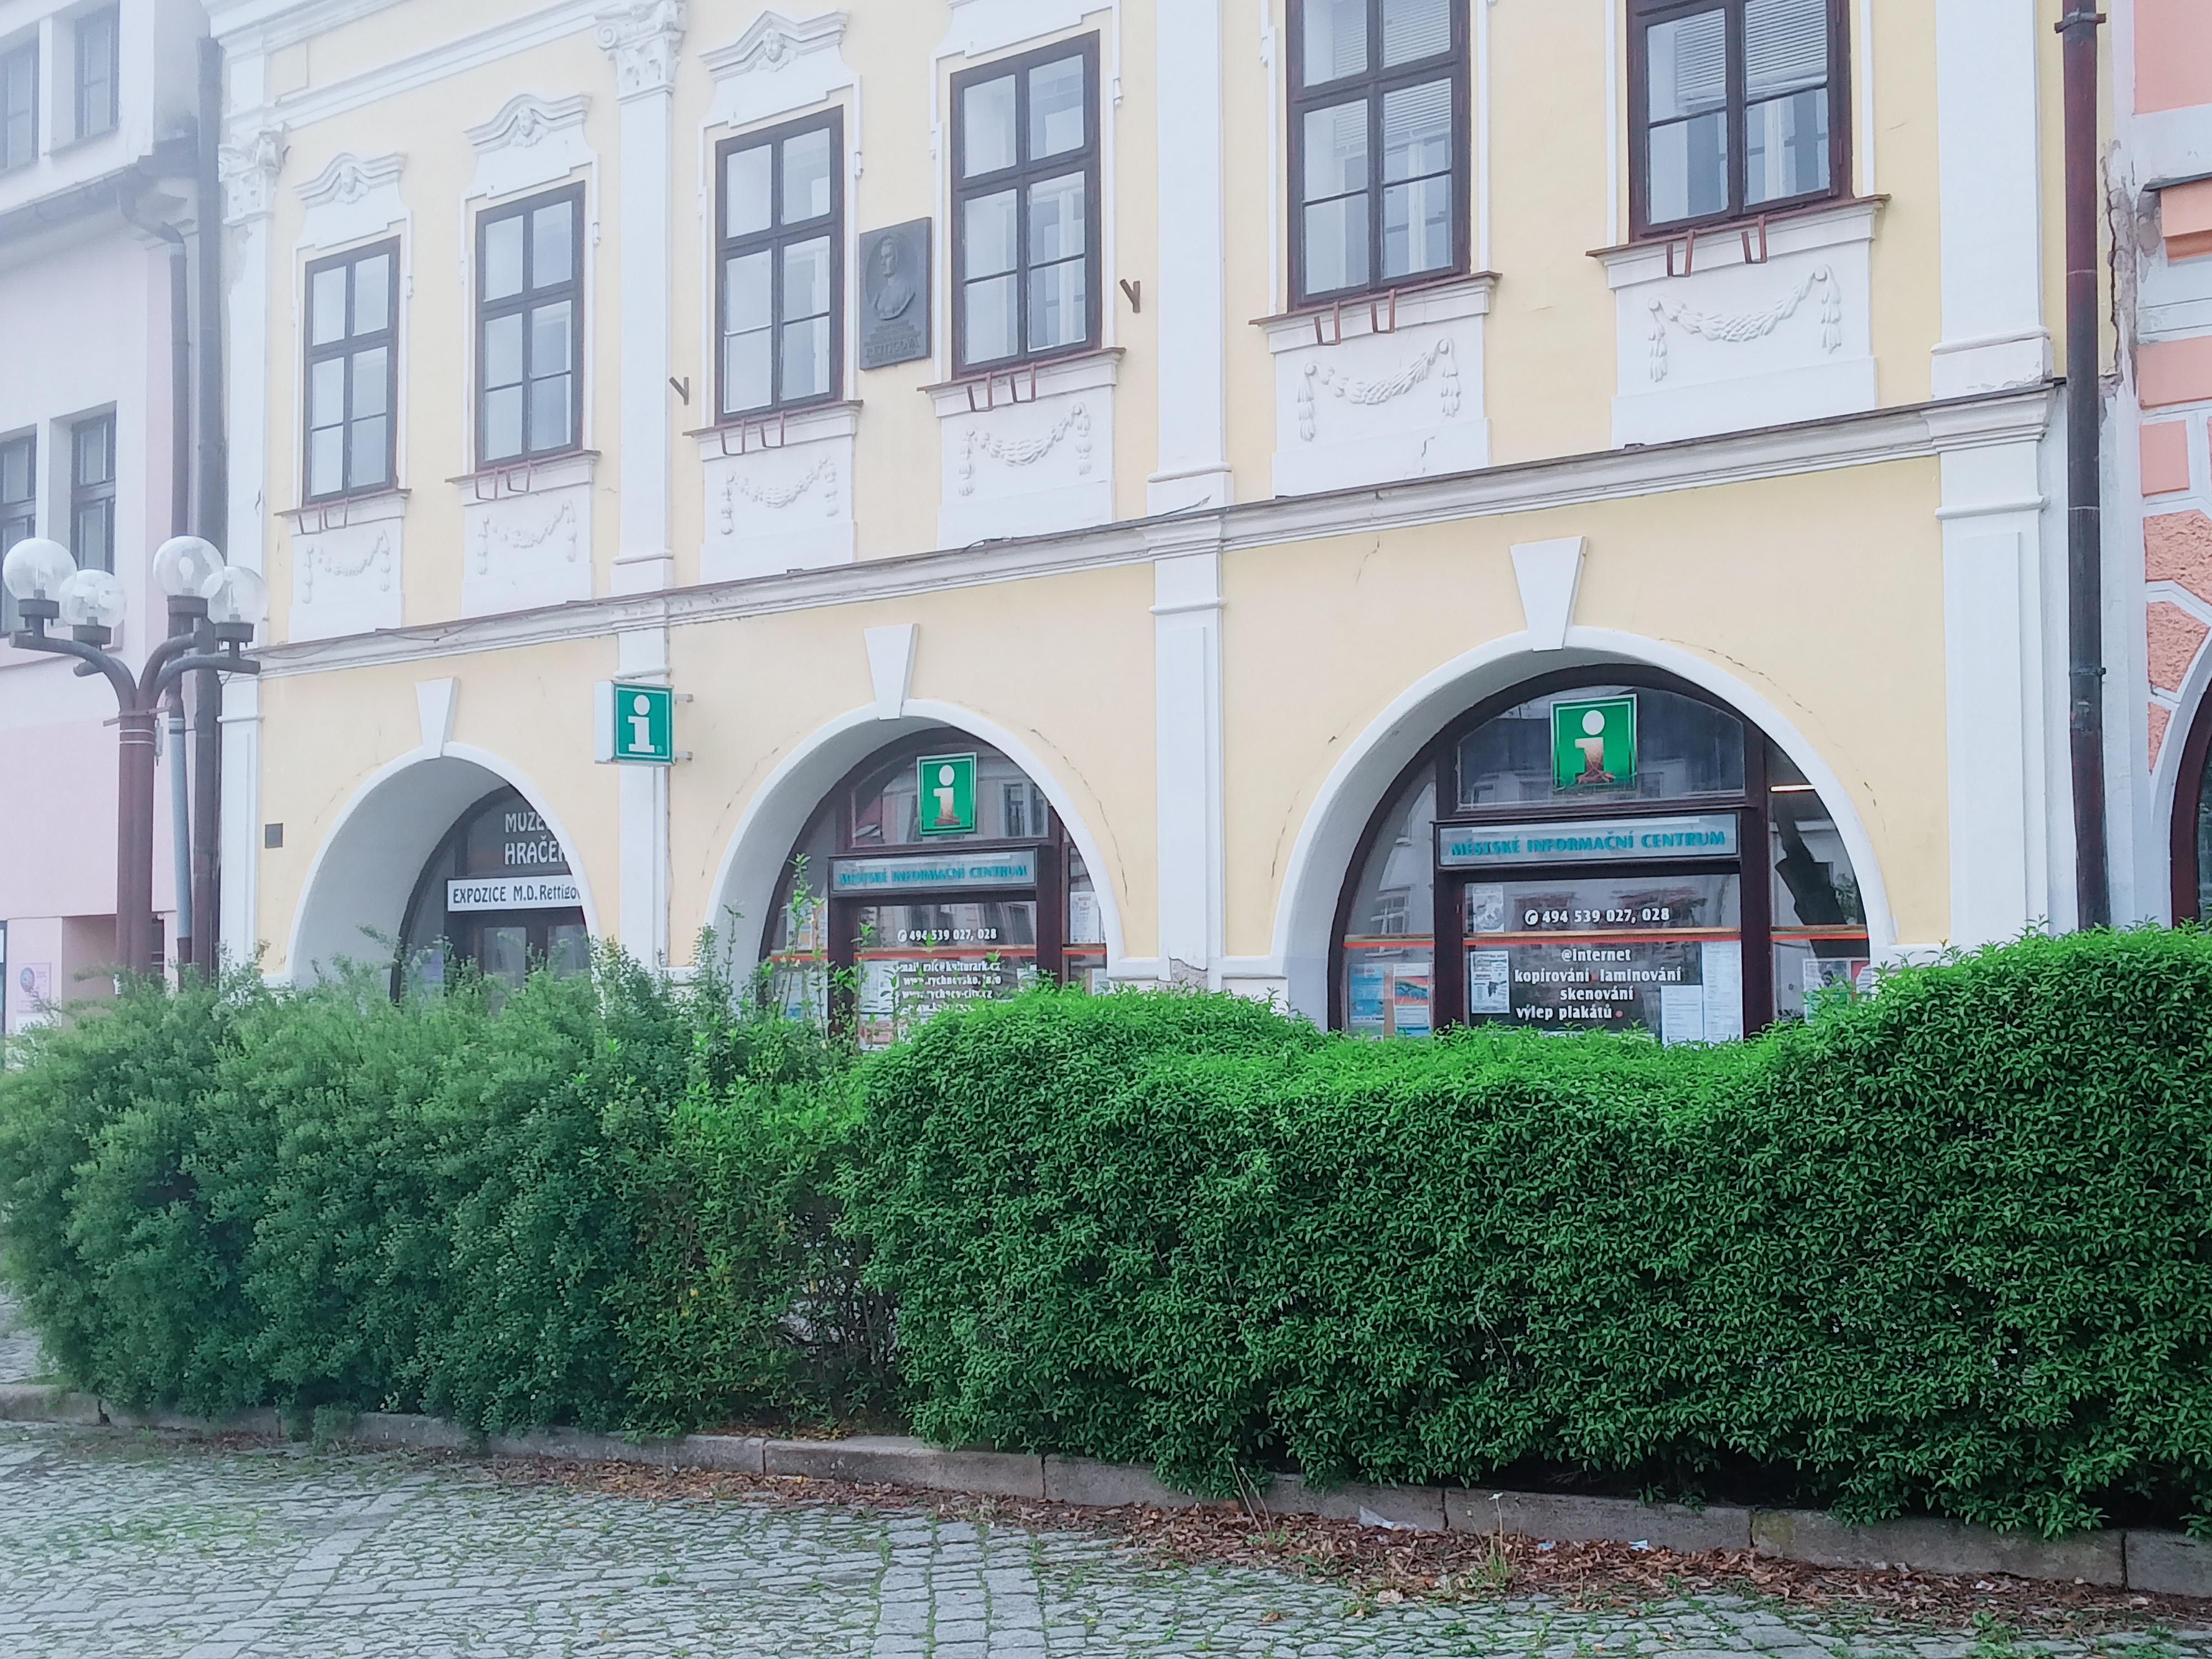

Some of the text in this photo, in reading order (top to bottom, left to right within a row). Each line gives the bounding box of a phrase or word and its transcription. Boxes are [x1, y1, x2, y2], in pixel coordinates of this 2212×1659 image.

[505, 812, 546, 833] MUZE
[1527, 831, 1634, 853] INFORMAČNÍ
[1641, 832, 1725, 848] CENTRUM
[453, 886, 506, 904] EXPOZICE
[1542, 907, 1670, 924] 494 539 027, 028
[931, 930, 950, 940] 539
[953, 929, 974, 941] 027,
[978, 928, 997, 939] 028
[1561, 948, 1631, 962] @internet
[1514, 966, 1682, 984] kopírování laminování
[1560, 985, 1634, 1001] skenování
[1516, 1004, 1612, 1021] výlep plakátů
